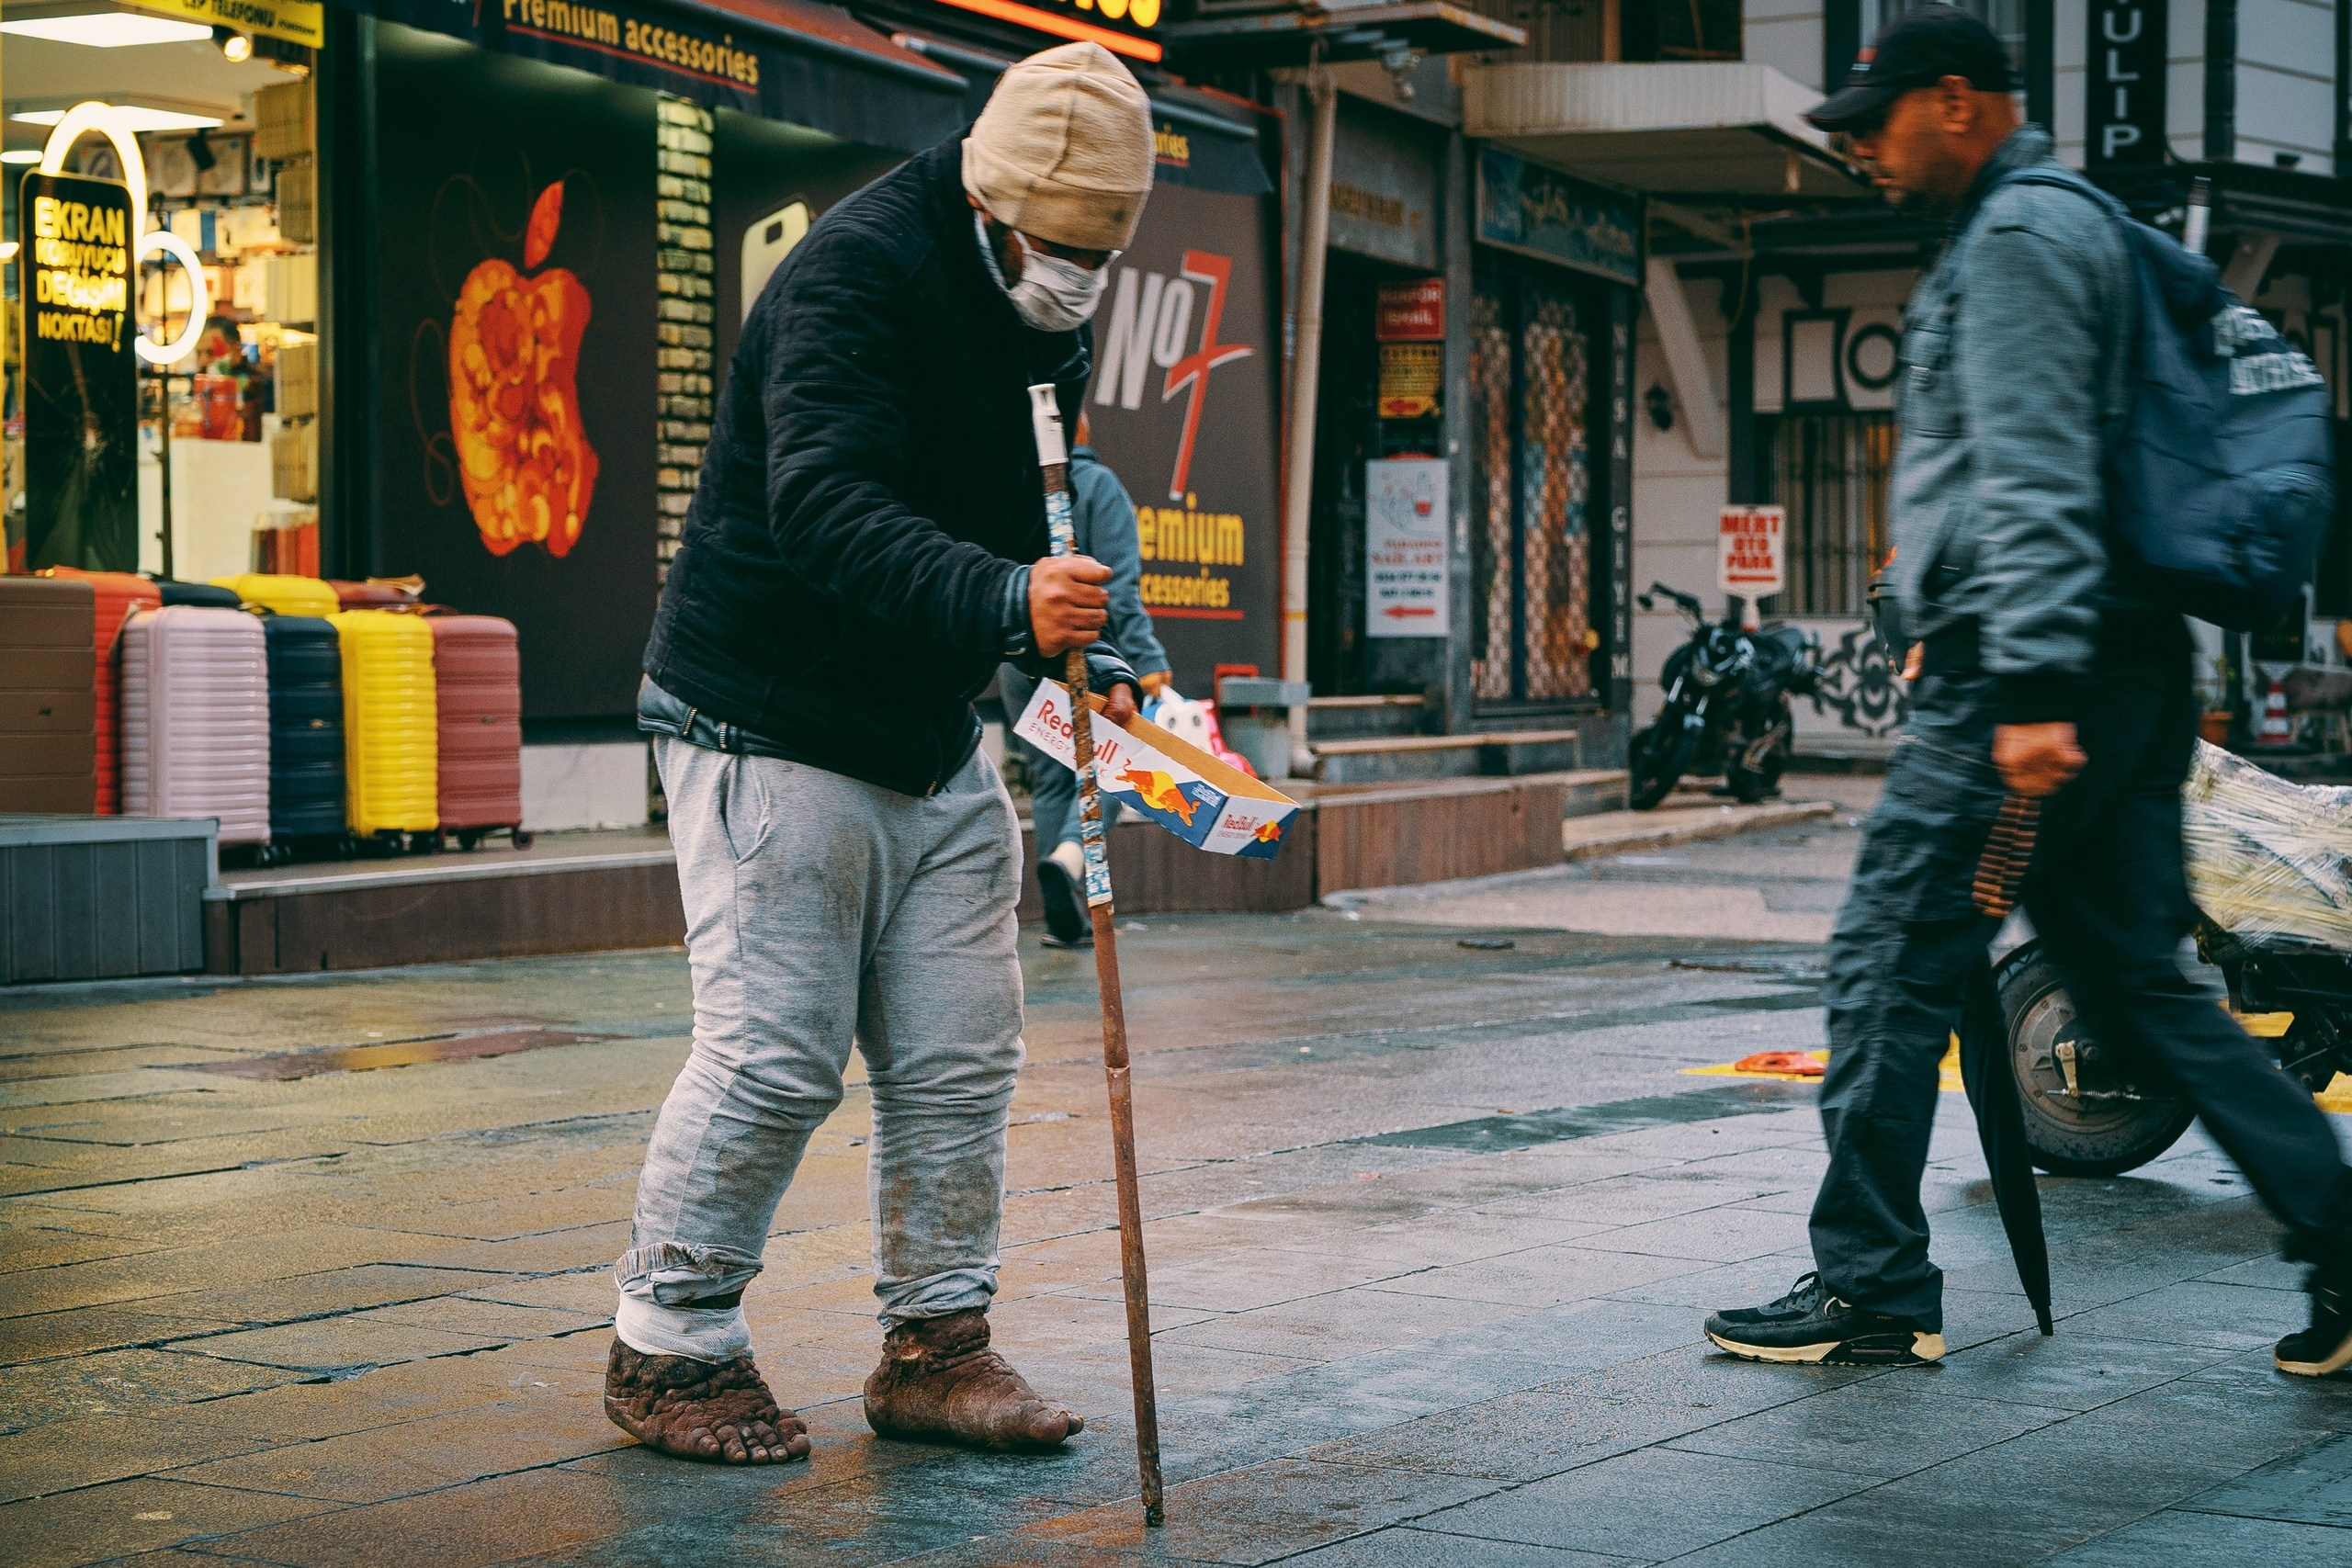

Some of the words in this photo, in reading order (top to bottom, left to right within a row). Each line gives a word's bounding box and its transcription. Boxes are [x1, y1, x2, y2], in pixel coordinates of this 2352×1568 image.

[625, 17, 760, 86] accessories
[2101, 0, 2143, 159] ULIP
[35, 196, 126, 247] EKRAN
[35, 237, 127, 275] KORUYUCU
[1133, 491, 1244, 567] emium
[1720, 514, 1781, 534] MERT
[1139, 566, 1230, 608] cessories
[1029, 722, 1072, 753] ENERGY
